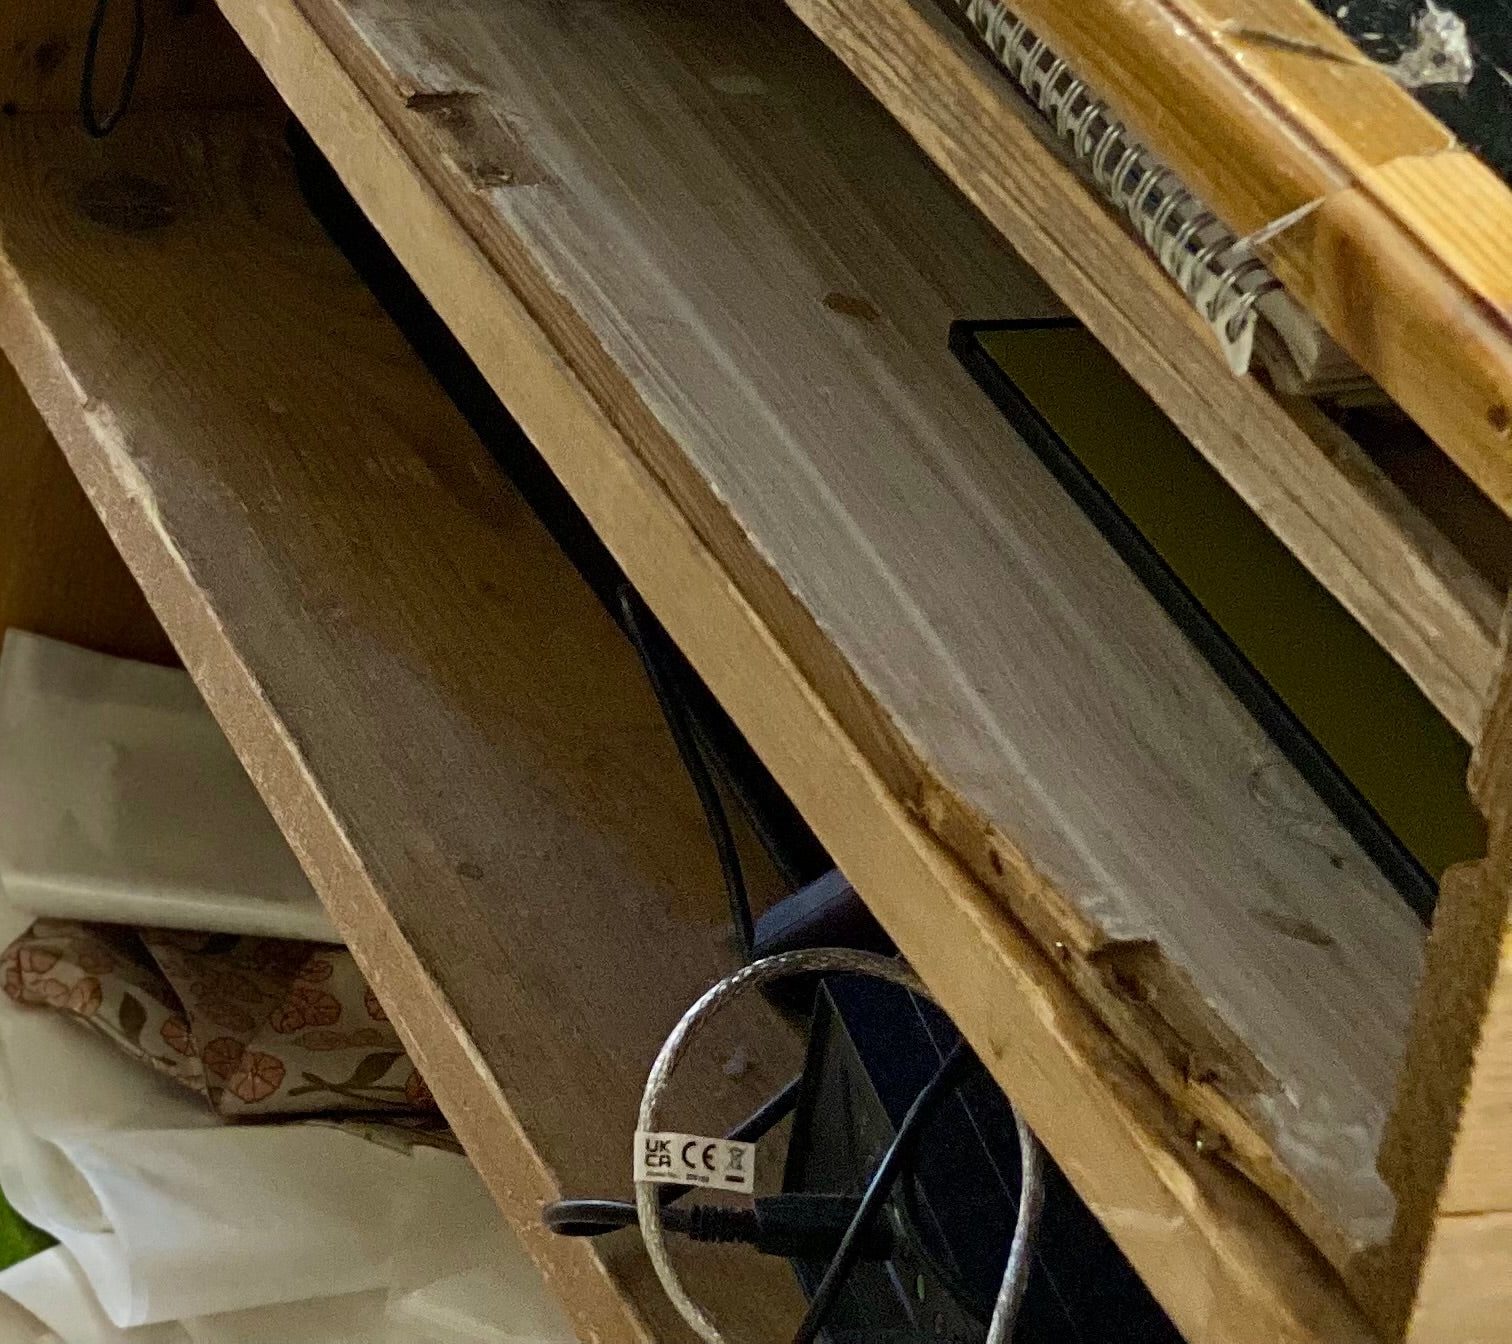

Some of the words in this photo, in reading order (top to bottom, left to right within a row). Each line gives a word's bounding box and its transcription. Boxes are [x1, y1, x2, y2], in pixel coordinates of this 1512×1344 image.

[646, 1139, 672, 1153] UK
[645, 1153, 671, 1167] CA
[681, 1141, 716, 1170] CE
